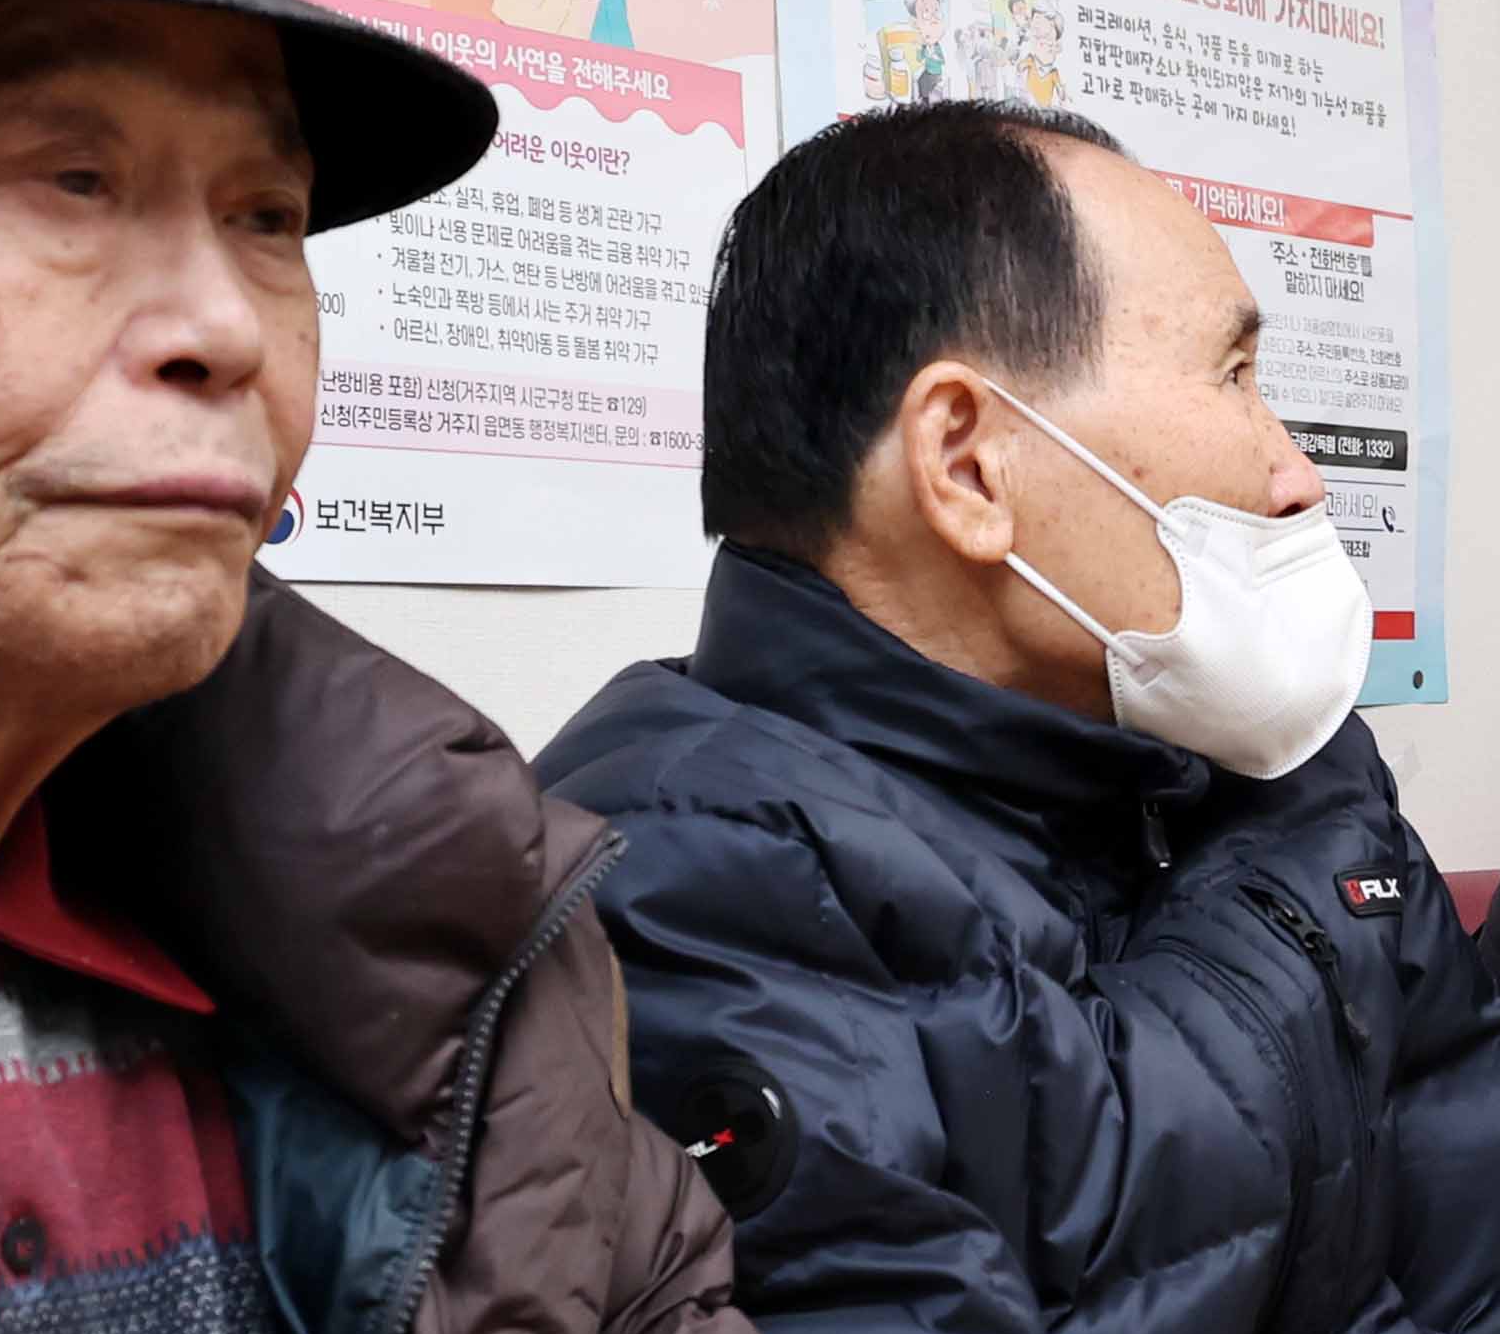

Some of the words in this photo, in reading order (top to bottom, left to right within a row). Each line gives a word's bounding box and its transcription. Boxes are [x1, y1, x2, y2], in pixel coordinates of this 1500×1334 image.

[503, 45, 566, 86] 사연을
[571, 57, 672, 101] 전해주세요
[550, 138, 630, 175] 이웃이란?
[389, 212, 434, 240] 빚이나
[438, 217, 467, 244] 신용
[471, 222, 515, 249] 문제로
[518, 228, 572, 258] 어려움을
[666, 247, 691, 272] 가구
[392, 285, 452, 313] 노숙인과
[455, 290, 484, 315] 쪽방
[488, 292, 530, 319] 등에서
[533, 298, 561, 323] 사는
[565, 301, 592, 327] 주거
[626, 307, 651, 332] 가구
[316, 498, 445, 534] 보건복지부
